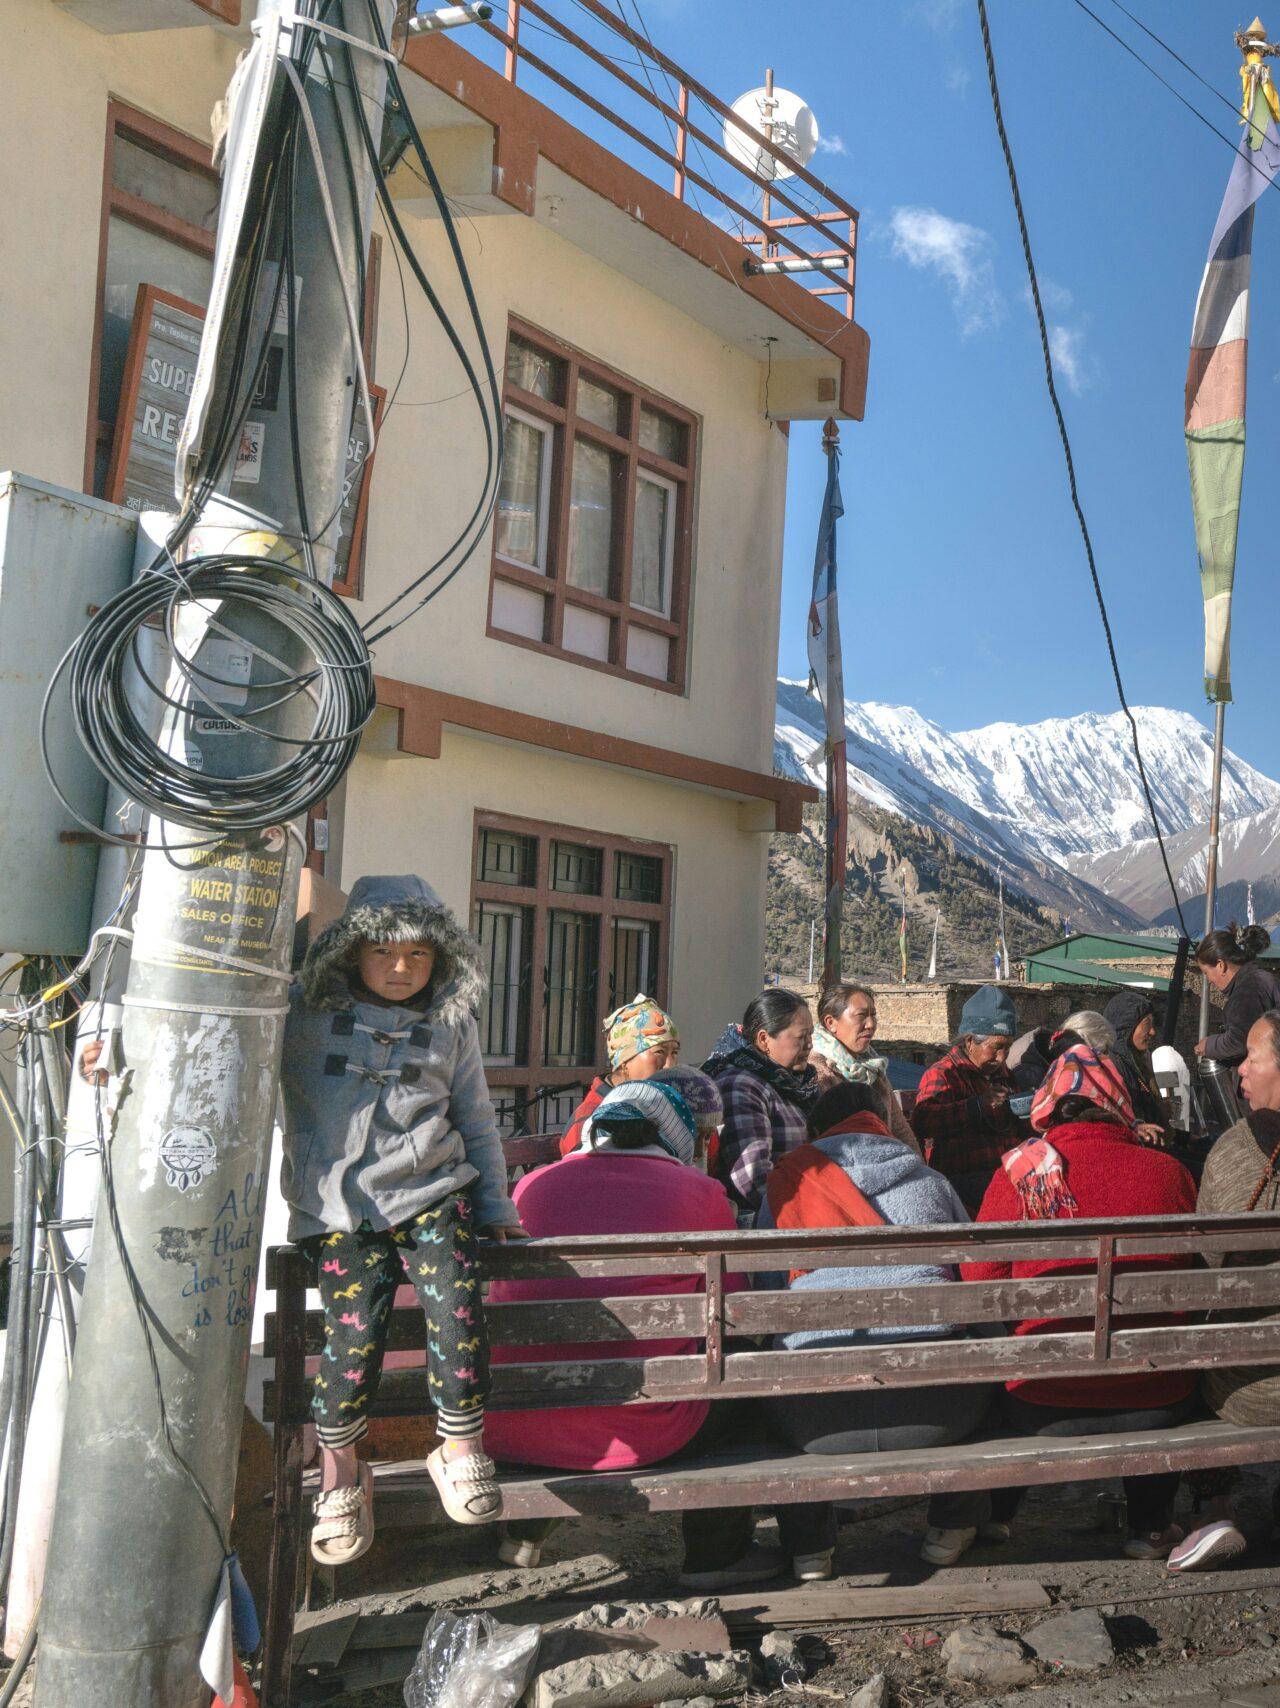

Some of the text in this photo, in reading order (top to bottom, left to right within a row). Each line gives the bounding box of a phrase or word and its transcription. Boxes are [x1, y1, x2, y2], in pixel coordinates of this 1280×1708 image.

[149, 358, 196, 397] SUPE
[189, 849, 282, 876] VATION AREA PROJECT
[190, 878, 233, 903] WATER
[234, 884, 279, 909] STATION
[180, 907, 264, 929] SALES OFFICE
[203, 935, 226, 945] NEAR
[228, 938, 239, 946] TO
[213, 1171, 264, 1222] All
[208, 1217, 254, 1257] that
[181, 1258, 238, 1298] don't
[194, 1306, 212, 1328] is
